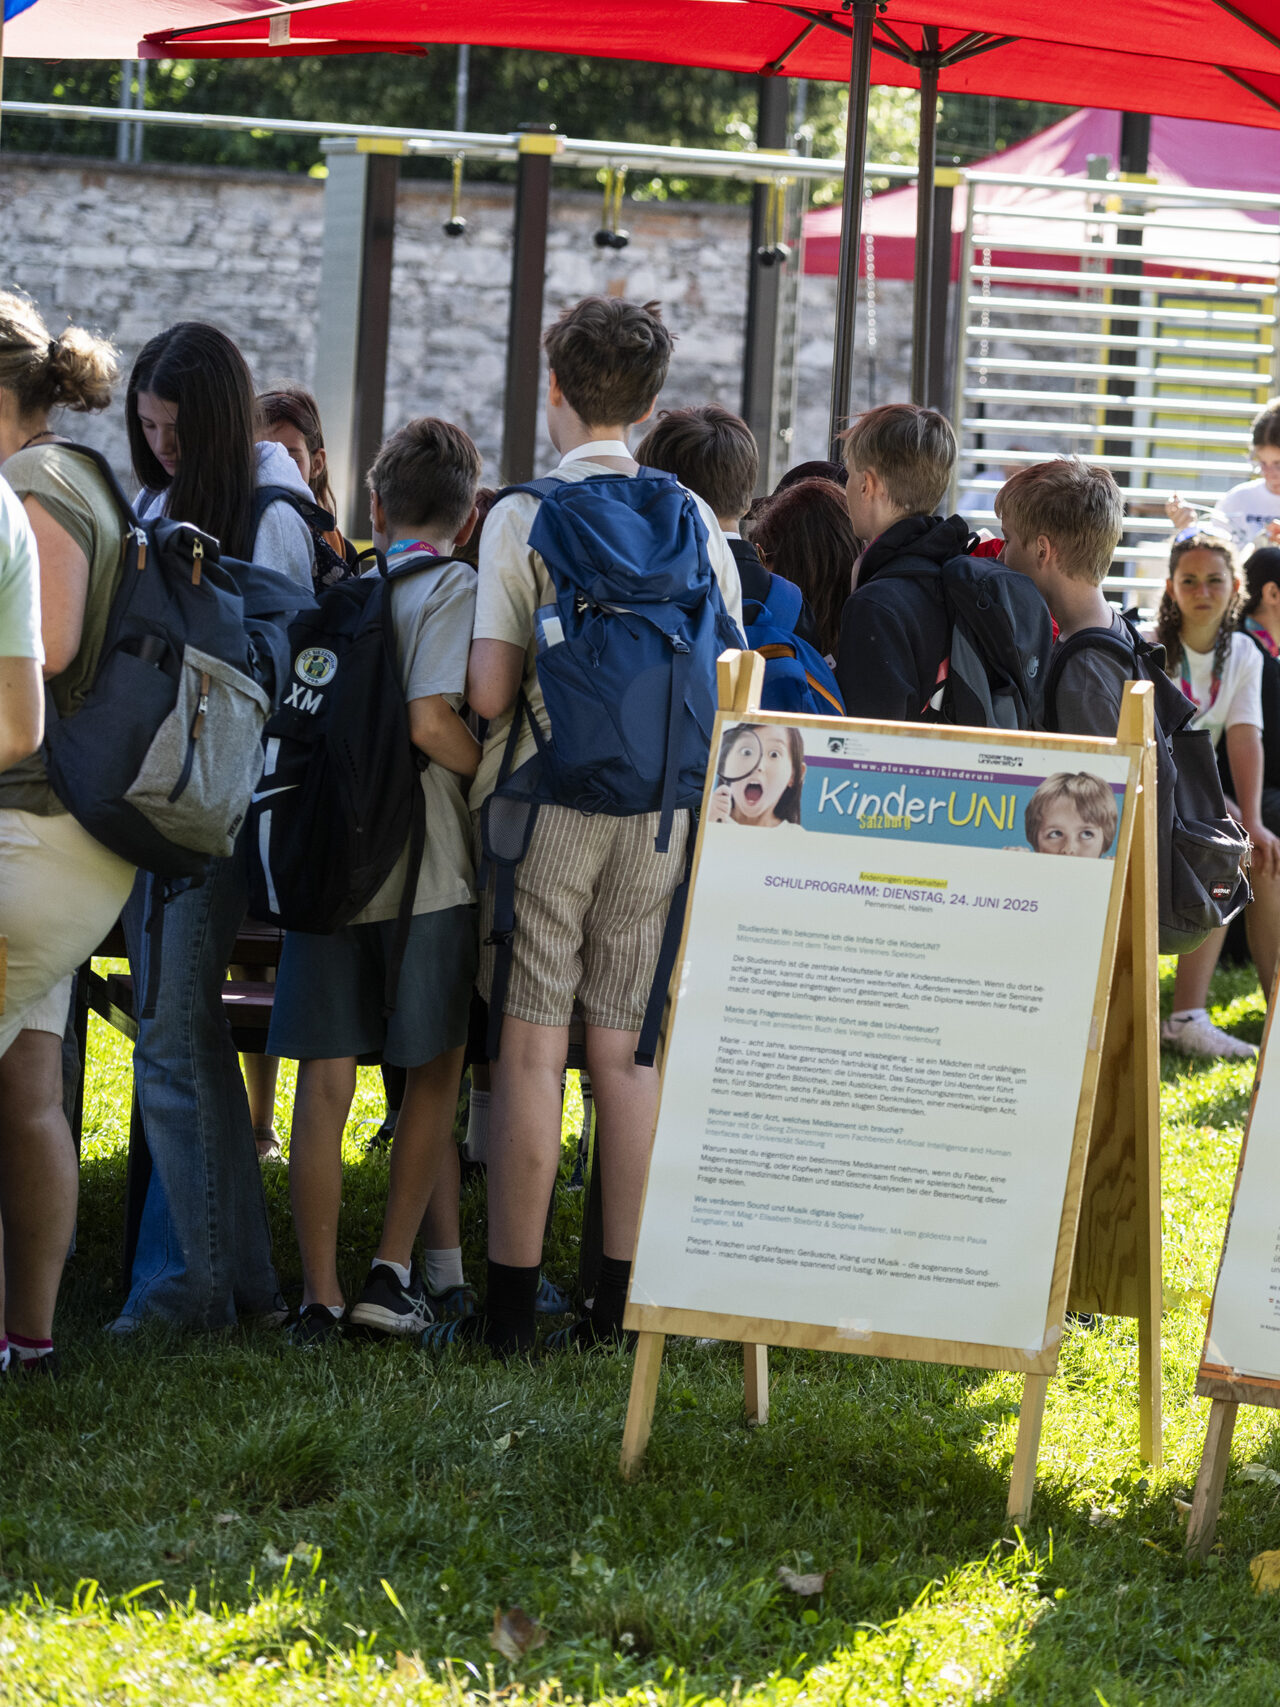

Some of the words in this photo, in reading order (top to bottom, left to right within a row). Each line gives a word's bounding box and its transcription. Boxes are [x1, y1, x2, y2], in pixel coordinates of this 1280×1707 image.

[283, 682, 324, 715] XM
[978, 753, 1023, 763] mozarteum
[853, 762, 994, 781] www.plus.ac.at/kinderuni
[818, 777, 1016, 831] KinderUNI
[859, 813, 912, 831] Salzburg
[763, 876, 878, 896] SCHULPROGRAMM:
[882, 887, 946, 904] DIENSTAG,
[949, 893, 968, 905] 24.
[973, 895, 1000, 907] JUNI
[1002, 898, 1038, 911] 2025
